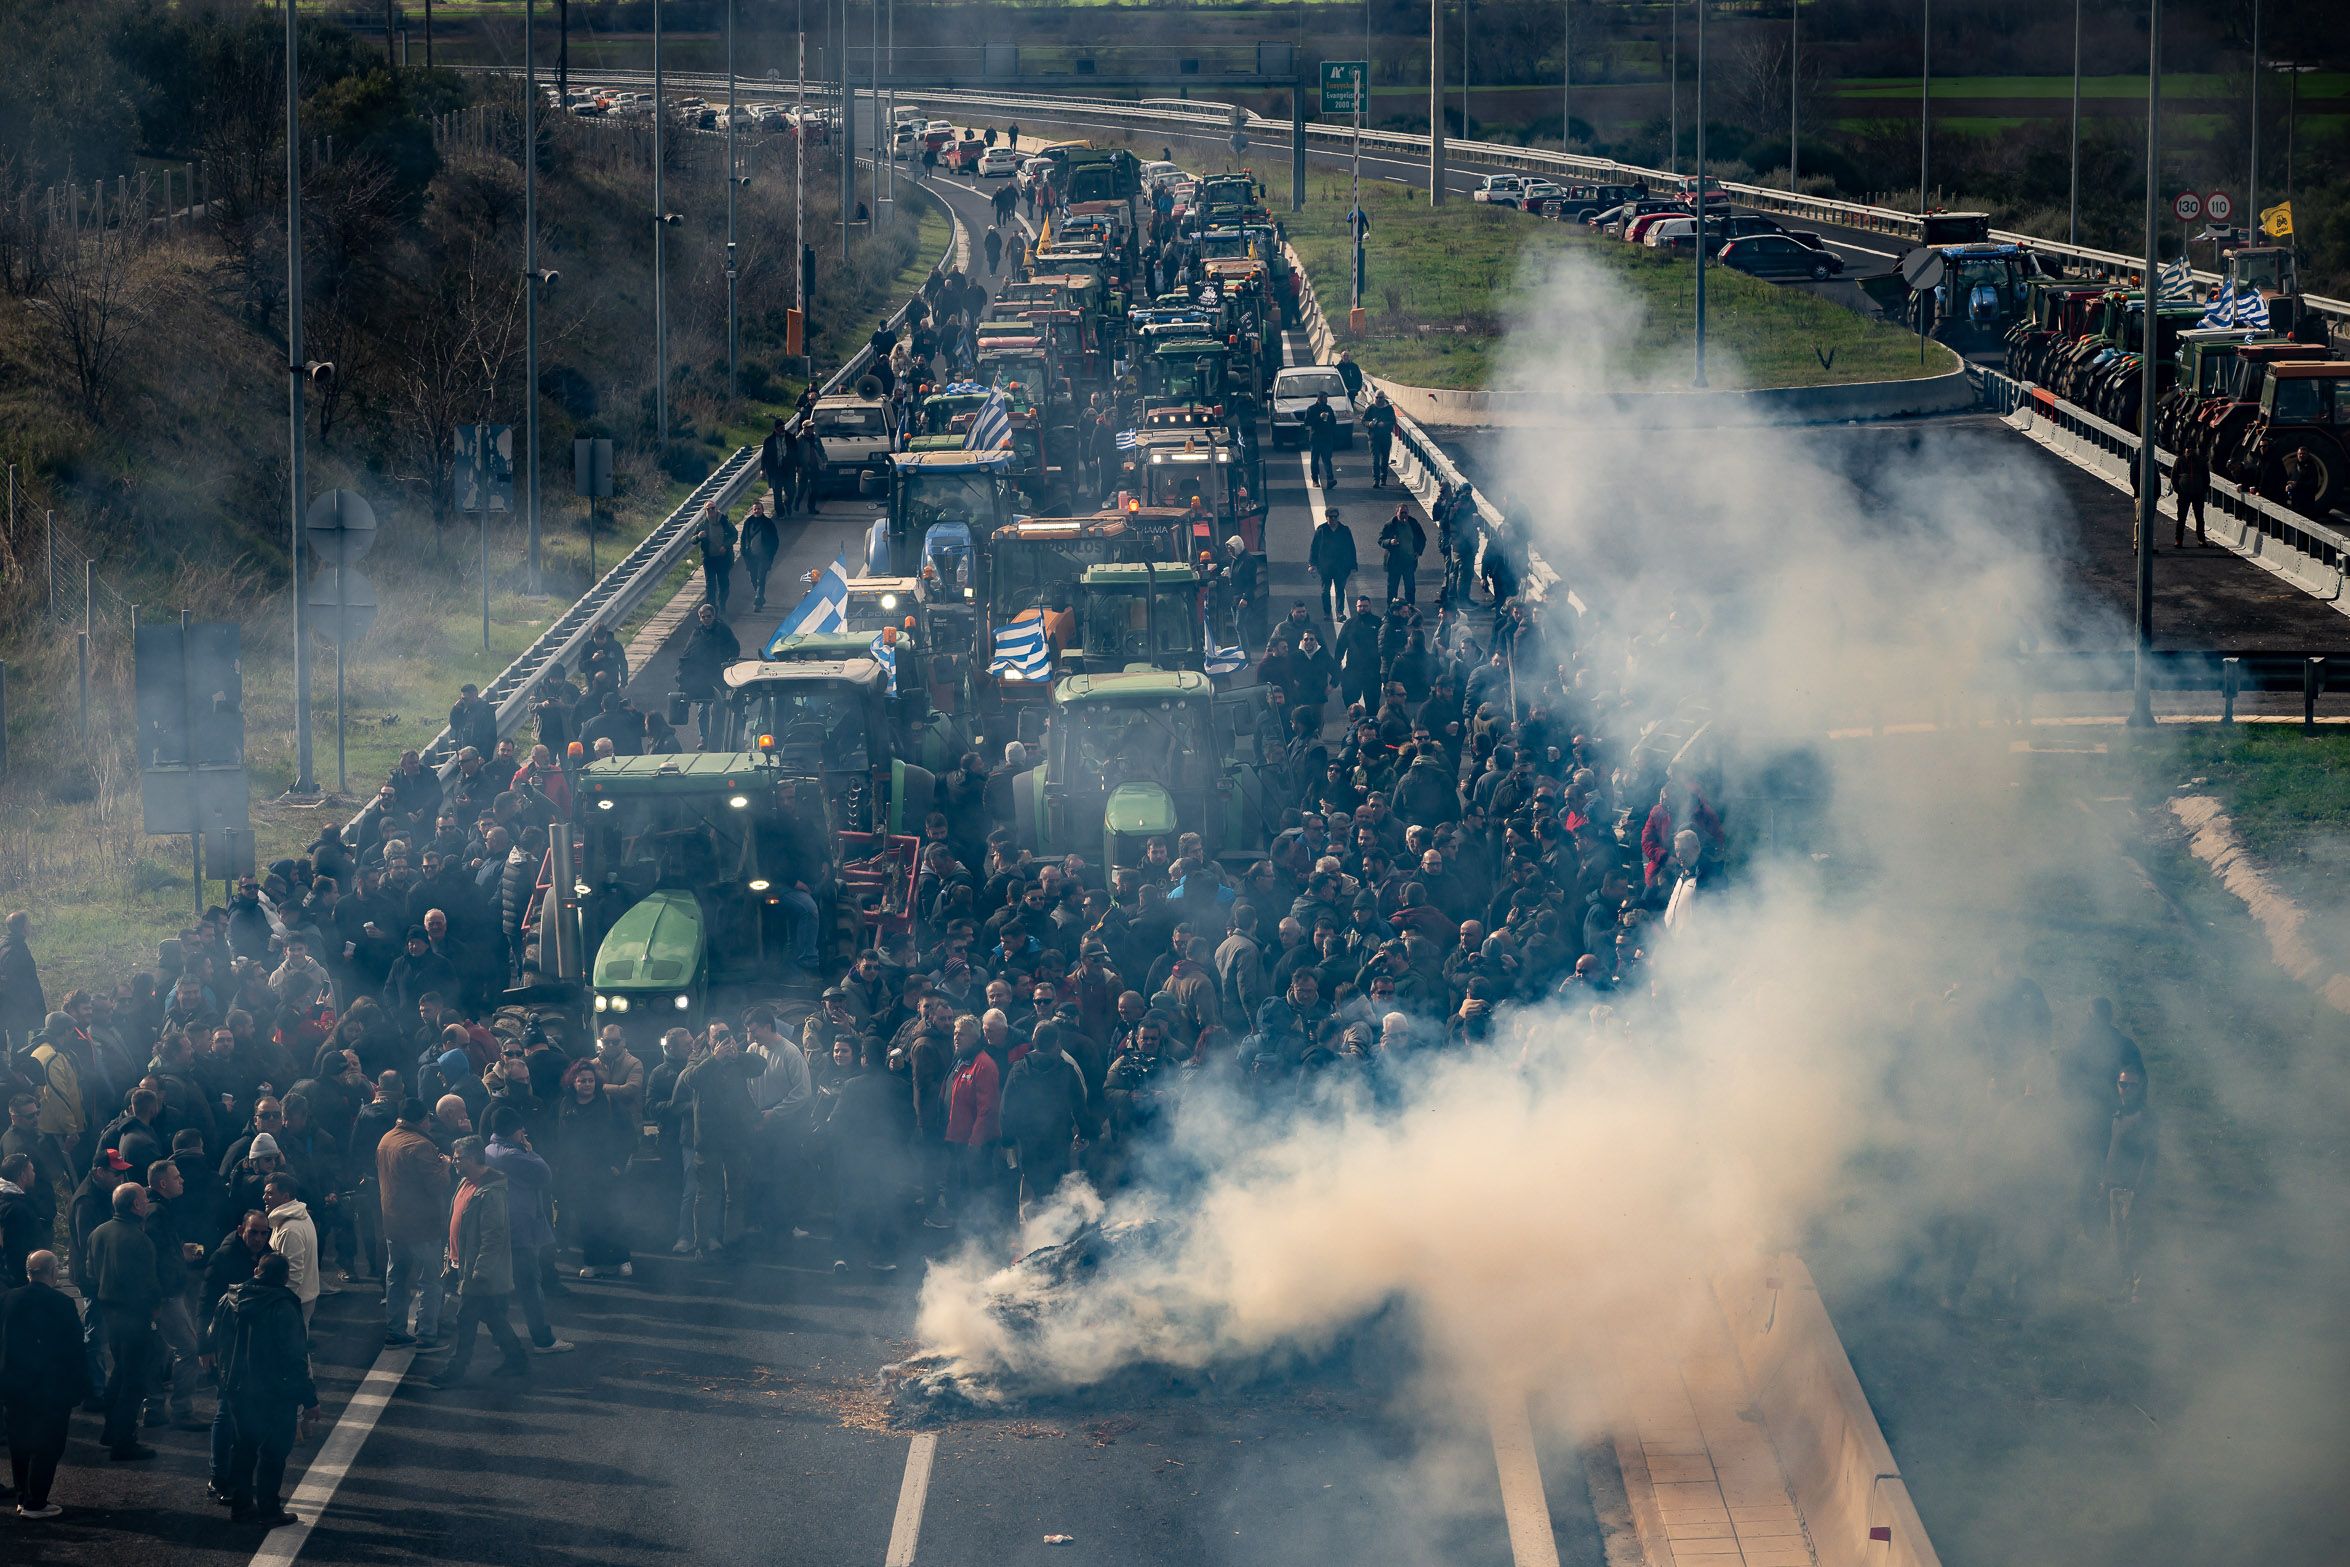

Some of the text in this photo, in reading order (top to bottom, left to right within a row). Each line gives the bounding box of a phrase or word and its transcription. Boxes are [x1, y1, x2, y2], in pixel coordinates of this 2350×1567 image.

[1335, 101, 1350, 109] 2000
[2178, 200, 2198, 213] 130
[2211, 200, 2227, 213] 110
